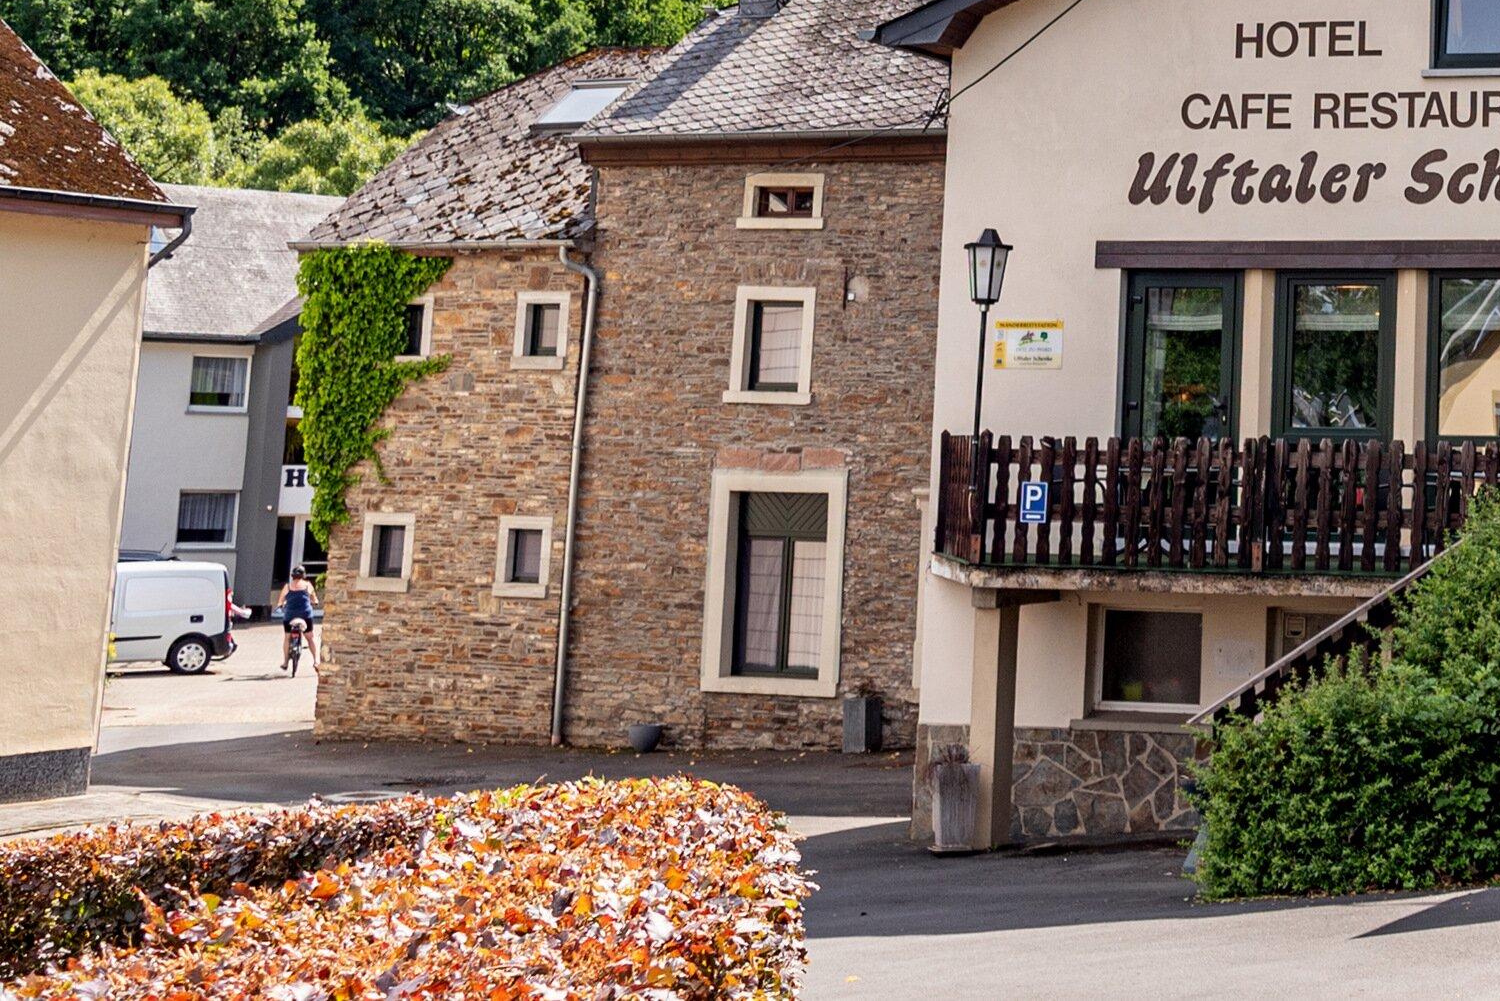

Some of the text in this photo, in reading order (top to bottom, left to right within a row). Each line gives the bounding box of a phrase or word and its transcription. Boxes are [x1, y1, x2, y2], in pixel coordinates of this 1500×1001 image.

[1234, 20, 1383, 59] HOTEL
[1181, 93, 1292, 130] CAFE
[1128, 150, 1387, 214] Ulftaler
[1025, 485, 1042, 510] P
